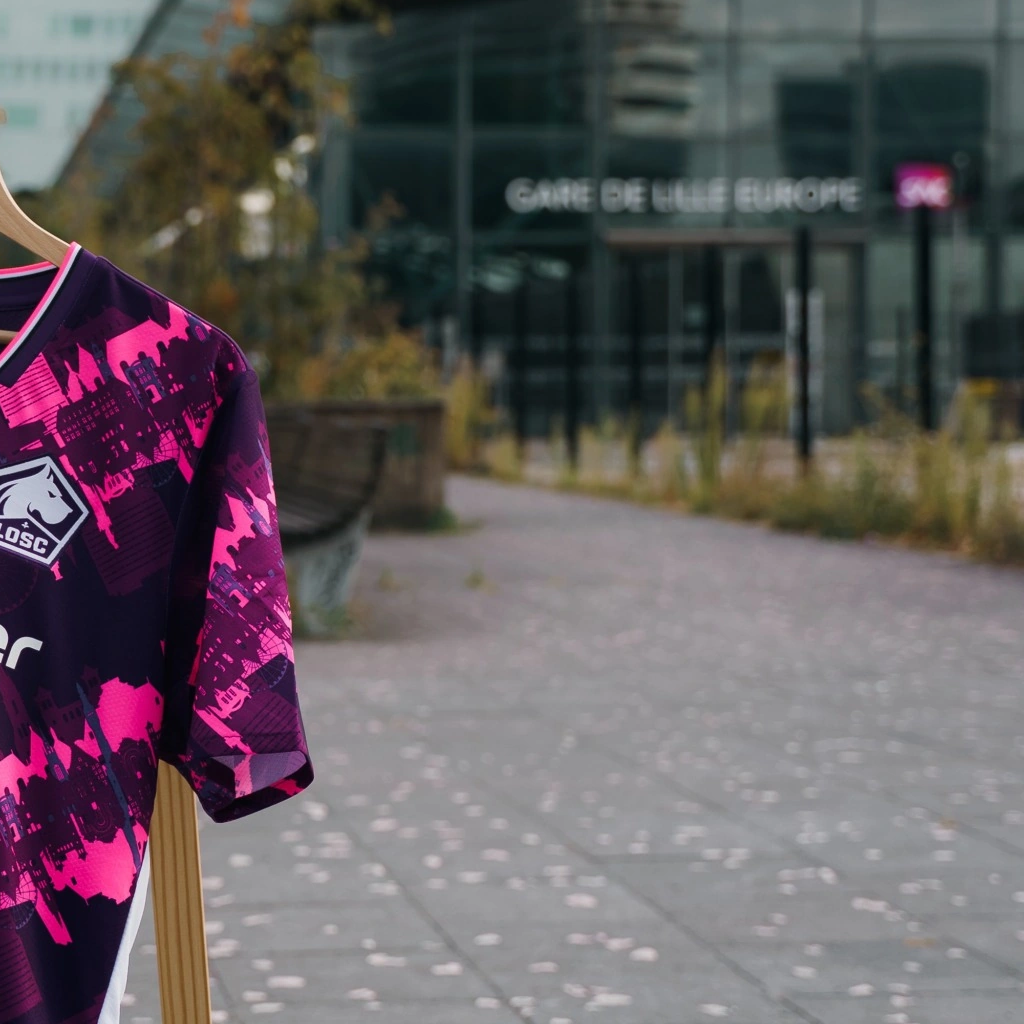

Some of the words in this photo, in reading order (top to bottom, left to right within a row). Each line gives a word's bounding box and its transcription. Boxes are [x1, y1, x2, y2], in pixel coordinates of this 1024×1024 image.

[505, 177, 595, 213] GARE
[601, 177, 647, 213] DE
[652, 177, 726, 213] LILLE
[734, 176, 864, 213] EUROPE
